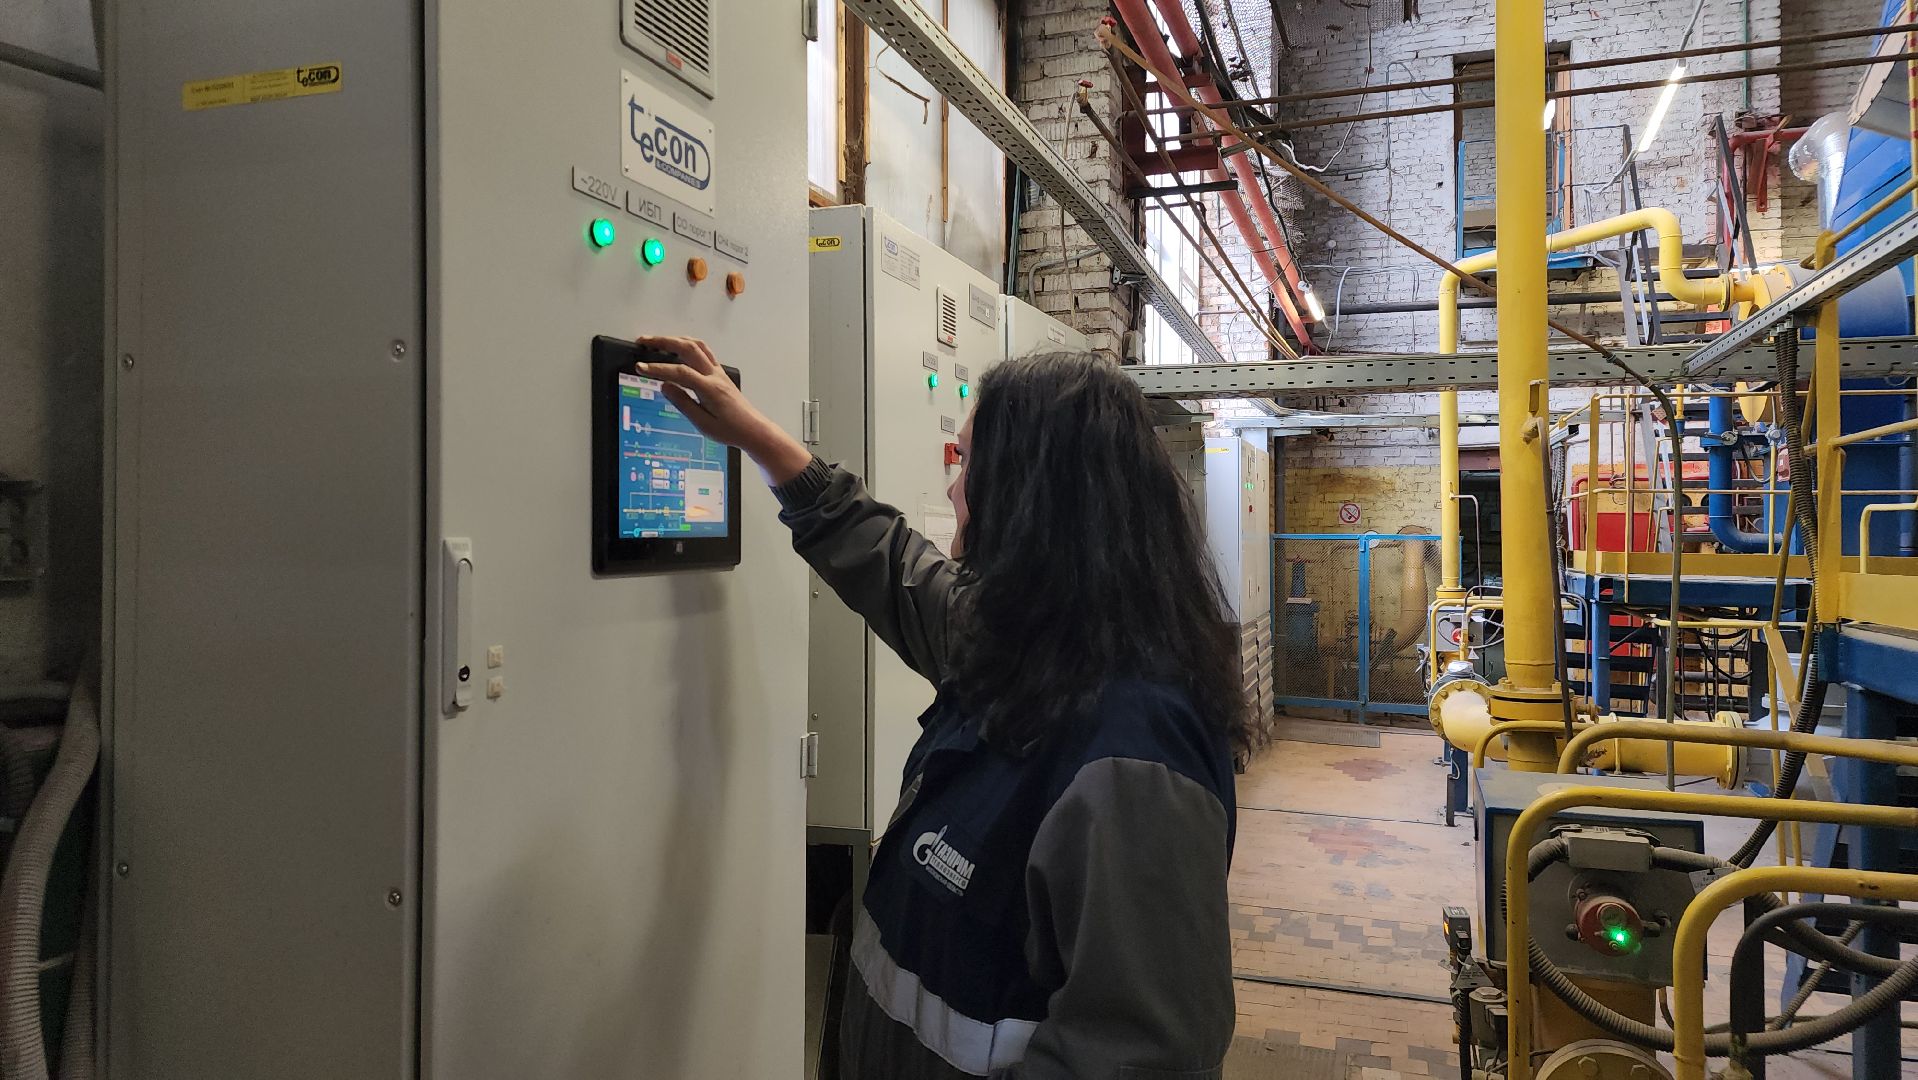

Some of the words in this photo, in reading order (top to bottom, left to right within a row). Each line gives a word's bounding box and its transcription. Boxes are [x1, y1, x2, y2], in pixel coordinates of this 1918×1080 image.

[627, 93, 699, 175] tecon
[580, 175, 618, 202] ~220V
[638, 197, 663, 221] ИБП
[933, 839, 976, 880] ГАЗПРОМ
